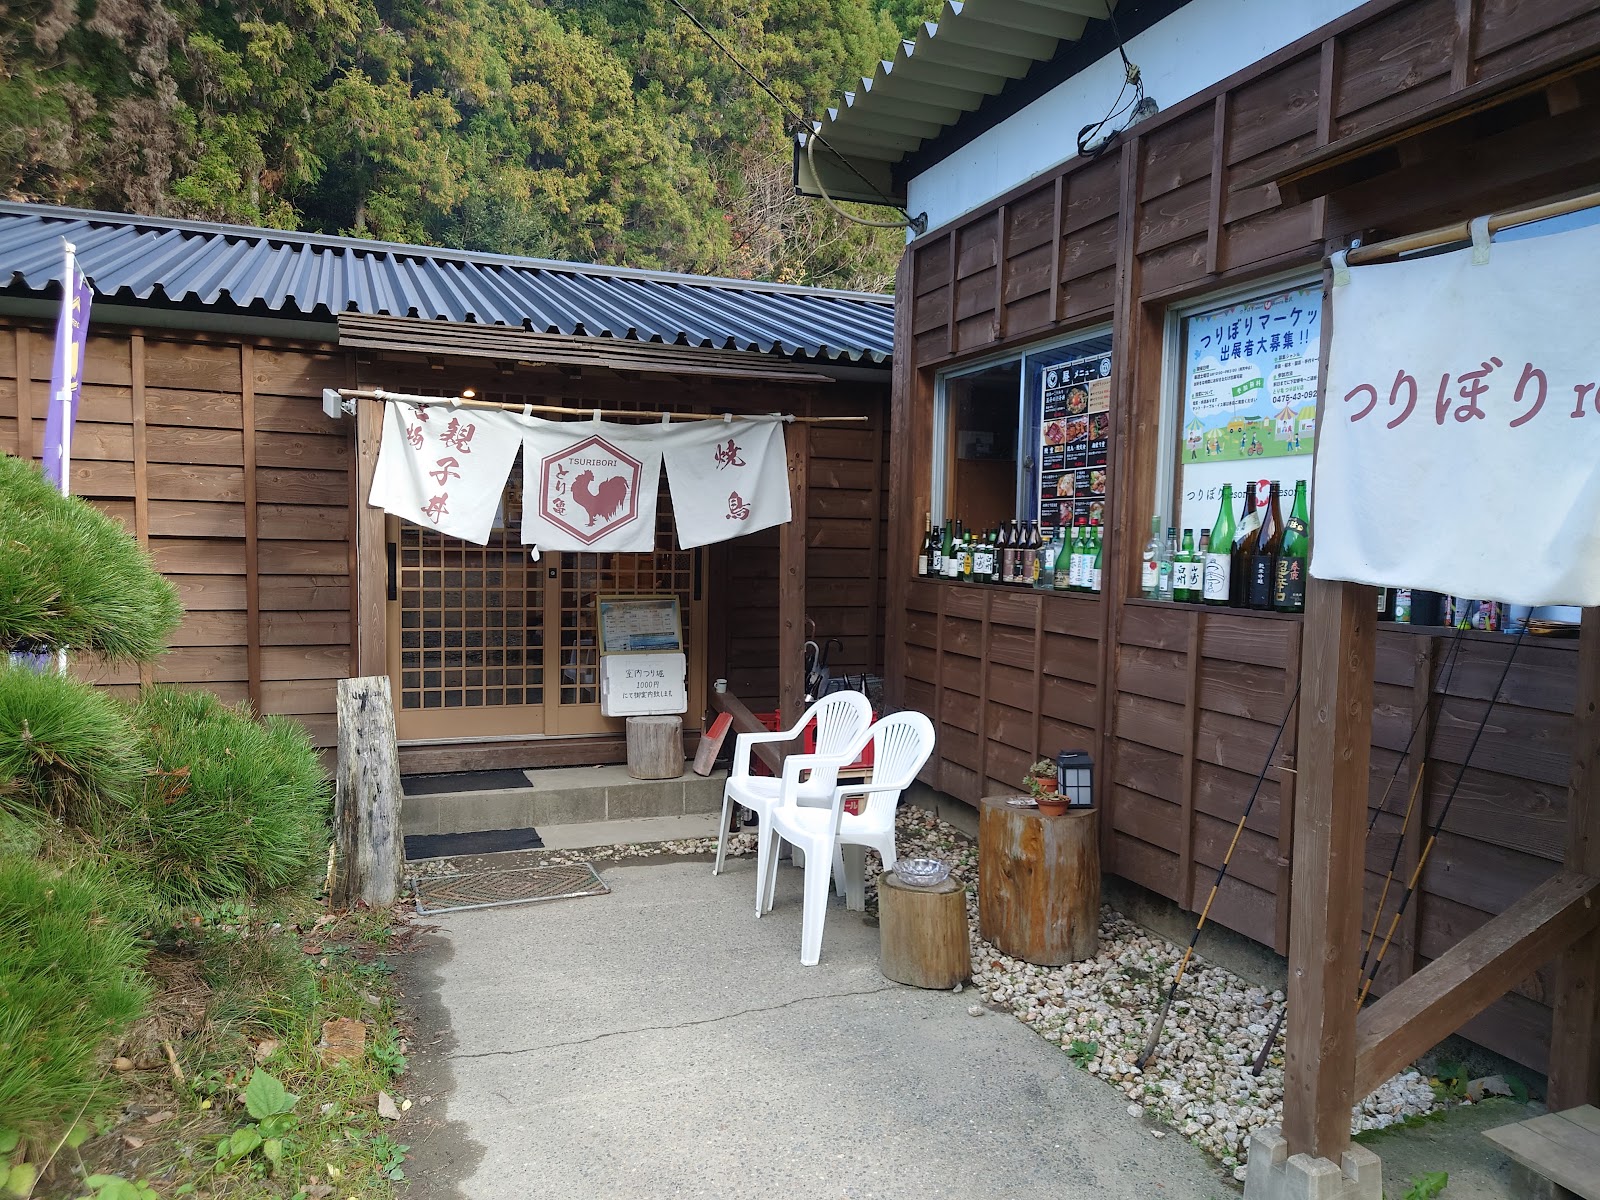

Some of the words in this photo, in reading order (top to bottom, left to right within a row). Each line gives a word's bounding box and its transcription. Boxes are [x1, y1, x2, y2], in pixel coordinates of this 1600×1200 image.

[1200, 306, 1318, 349] つりぼりマーケッ
[1219, 328, 1310, 362] 出展者大募集!!
[1073, 368, 1096, 379] メニュー
[1272, 390, 1318, 404] 0475-43-092
[1344, 356, 1548, 430] つりぼり
[421, 417, 475, 524] 親子丼
[568, 457, 618, 467] TSURIBORI
[715, 438, 752, 522] 焼鳥
[1176, 565, 1187, 585] 白州
[1290, 560, 1301, 581] 春鹿
[625, 669, 665, 679] 室内つり堀
[636, 681, 660, 689] 1000円
